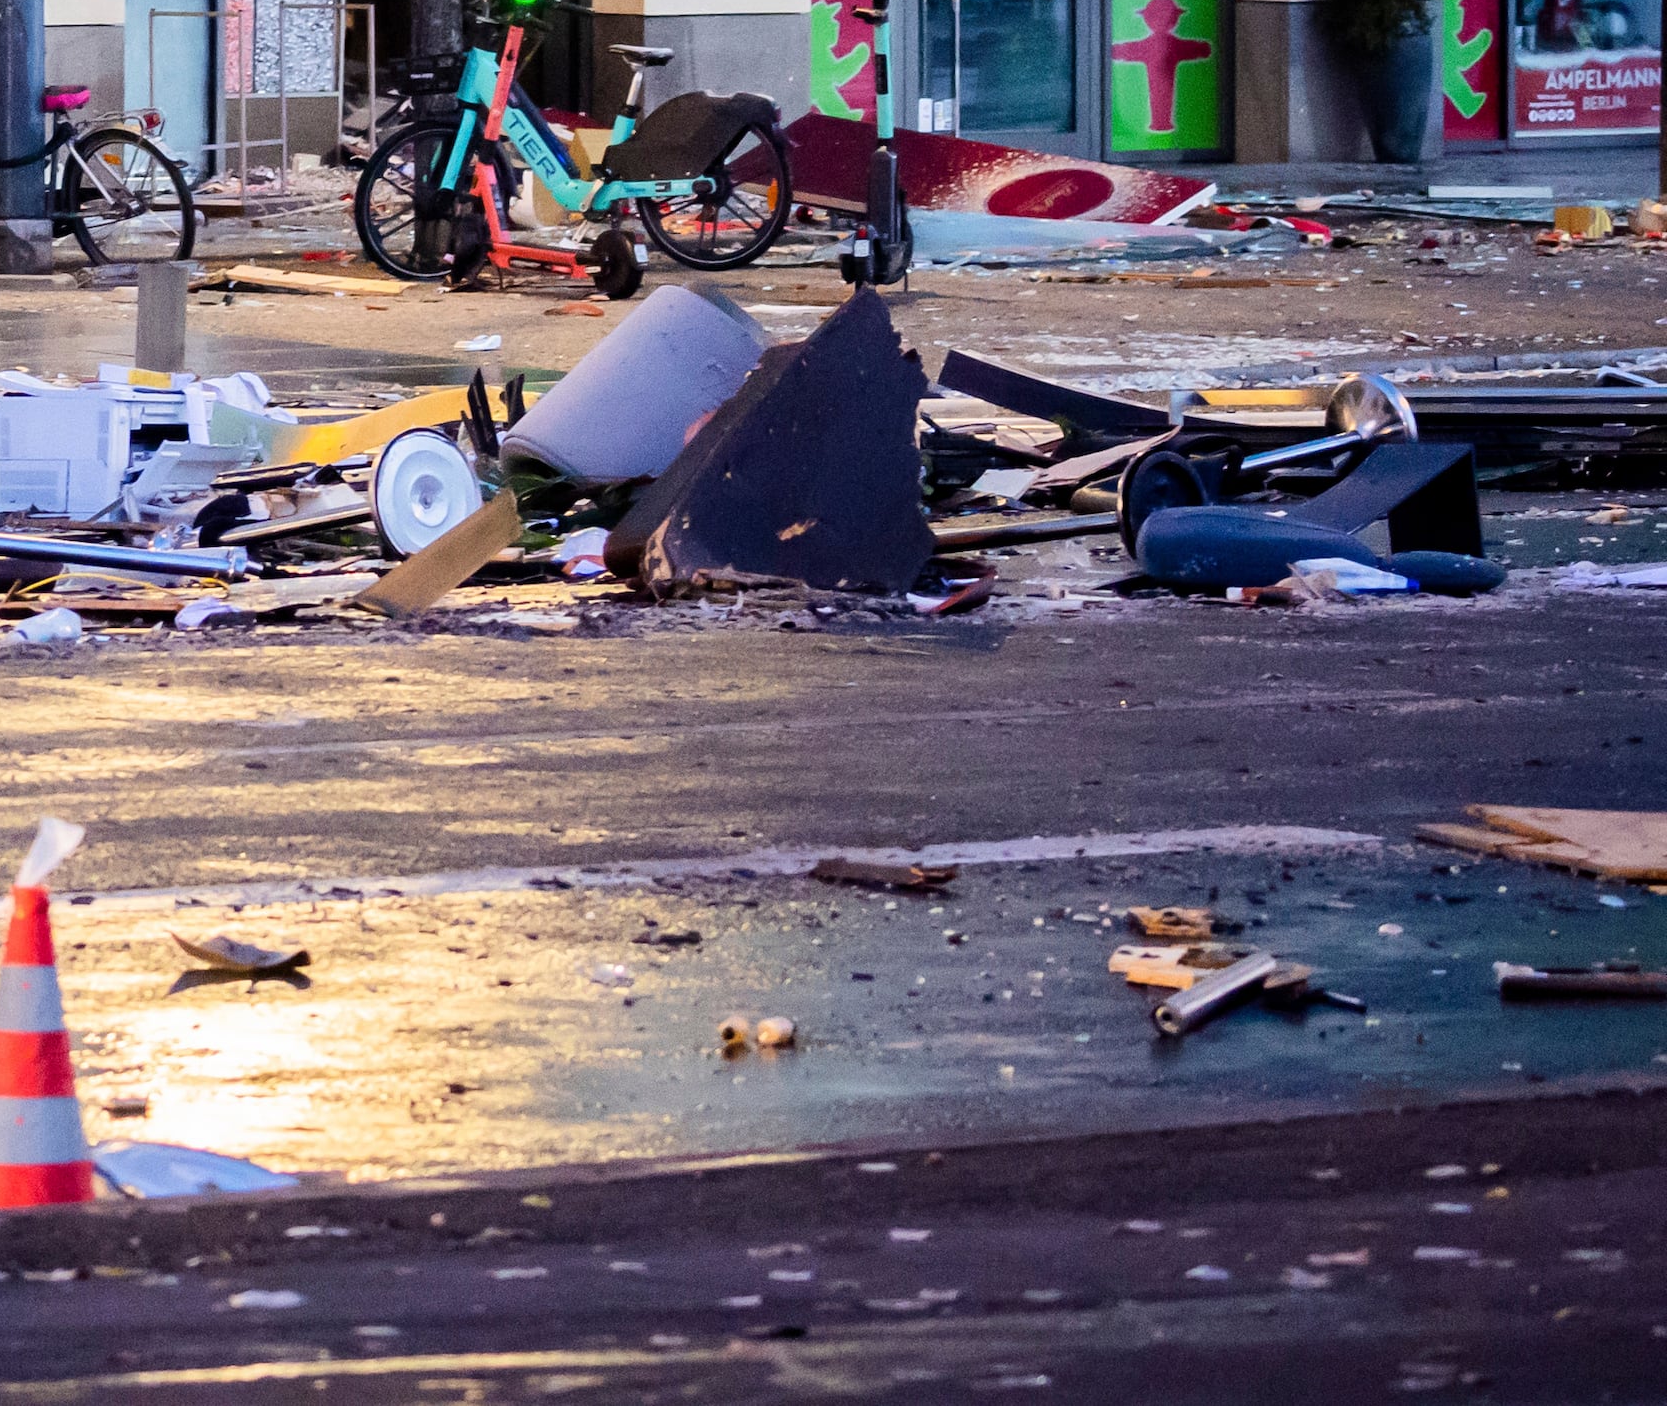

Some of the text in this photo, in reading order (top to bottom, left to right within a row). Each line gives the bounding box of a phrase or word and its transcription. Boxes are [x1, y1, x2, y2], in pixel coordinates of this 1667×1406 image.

[1545, 67, 1661, 90] AMPELMANN
[1582, 95, 1627, 110] BERLIN
[508, 112, 558, 179] TIER
